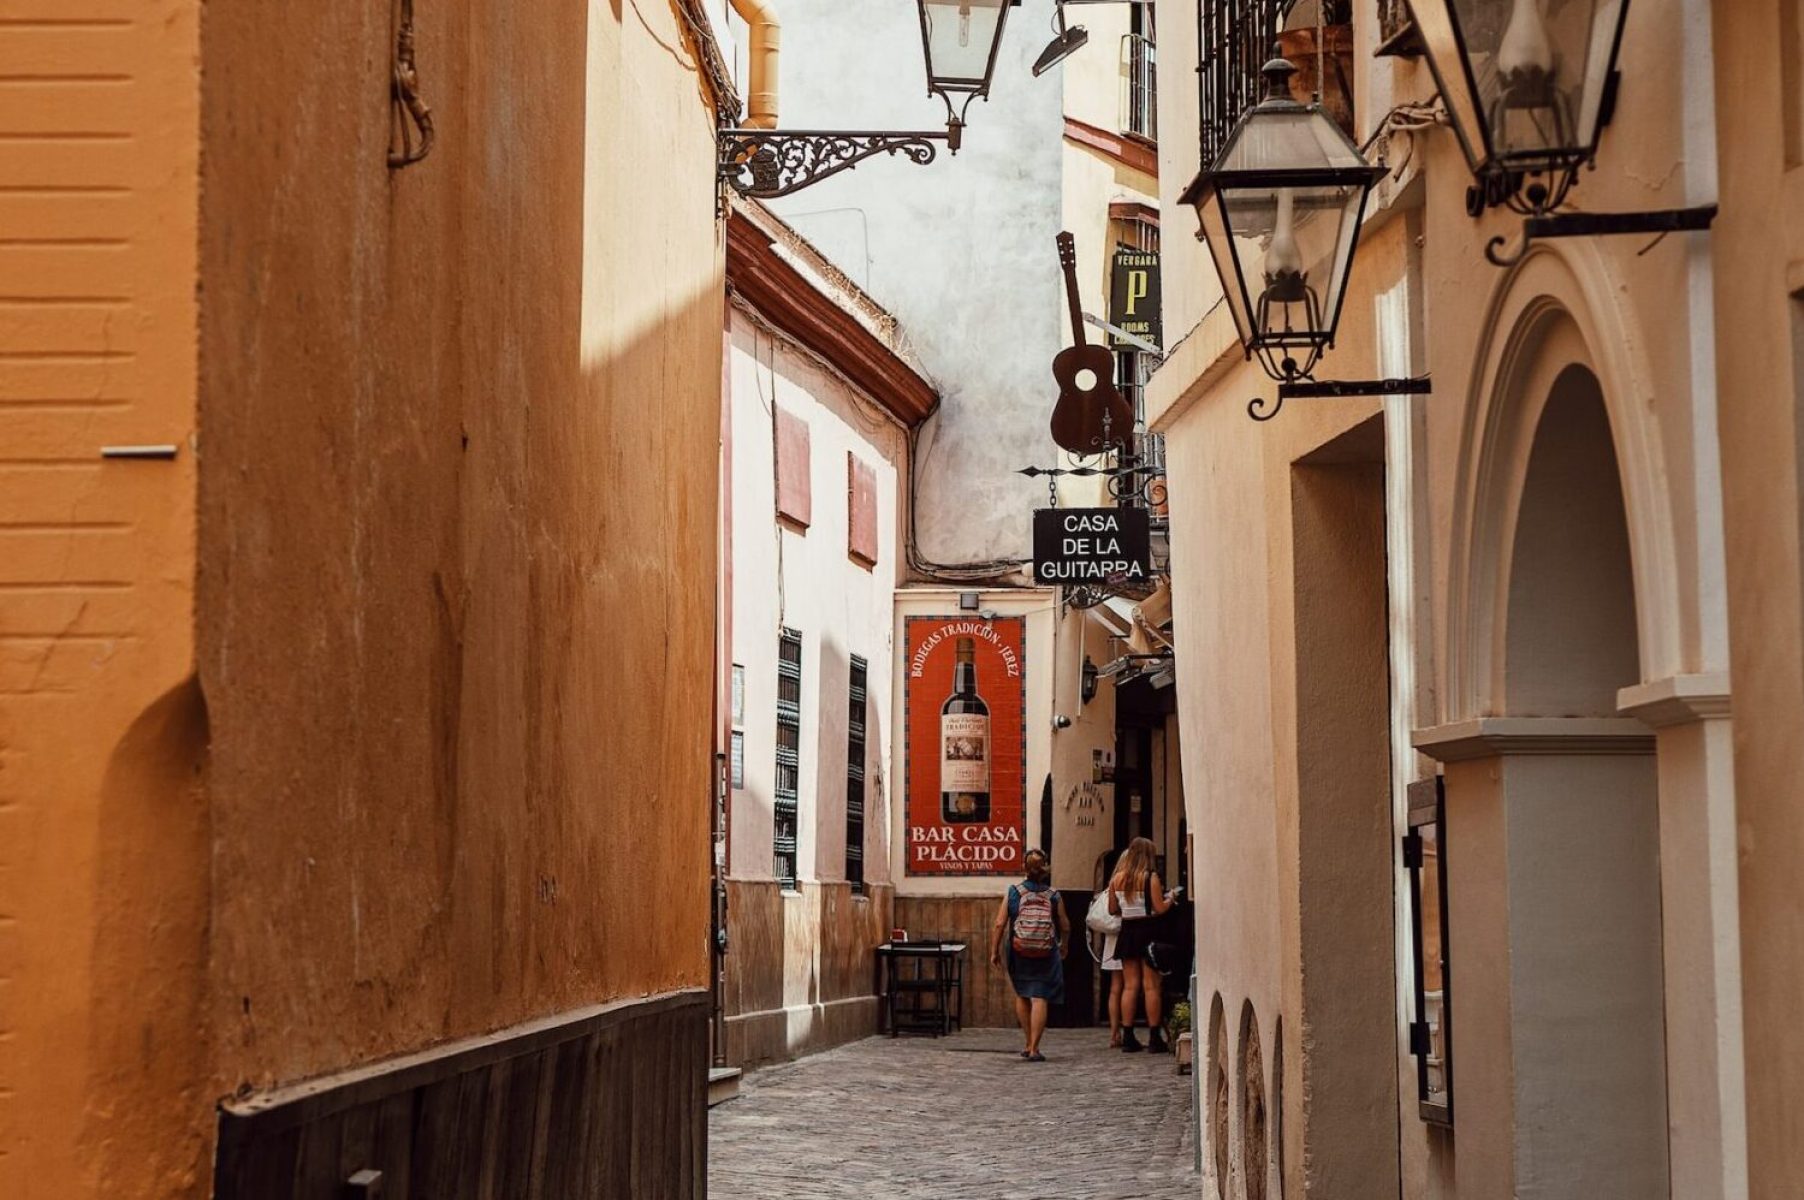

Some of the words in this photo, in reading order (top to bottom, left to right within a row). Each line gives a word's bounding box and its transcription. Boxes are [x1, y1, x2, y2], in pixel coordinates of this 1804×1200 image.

[1117, 255, 1158, 266] VERGARA
[1124, 270, 1147, 315] P
[1064, 515, 1119, 532] CASA
[1063, 538, 1090, 555] DE
[1096, 538, 1121, 555] LA
[1041, 560, 1143, 578] GUITARRA
[911, 632, 941, 678] BODEGAS
[999, 646, 1020, 678] JEREZ
[912, 826, 956, 842] BAR
[962, 826, 1020, 842] CASA
[916, 842, 1016, 861] PLÁCIDO
